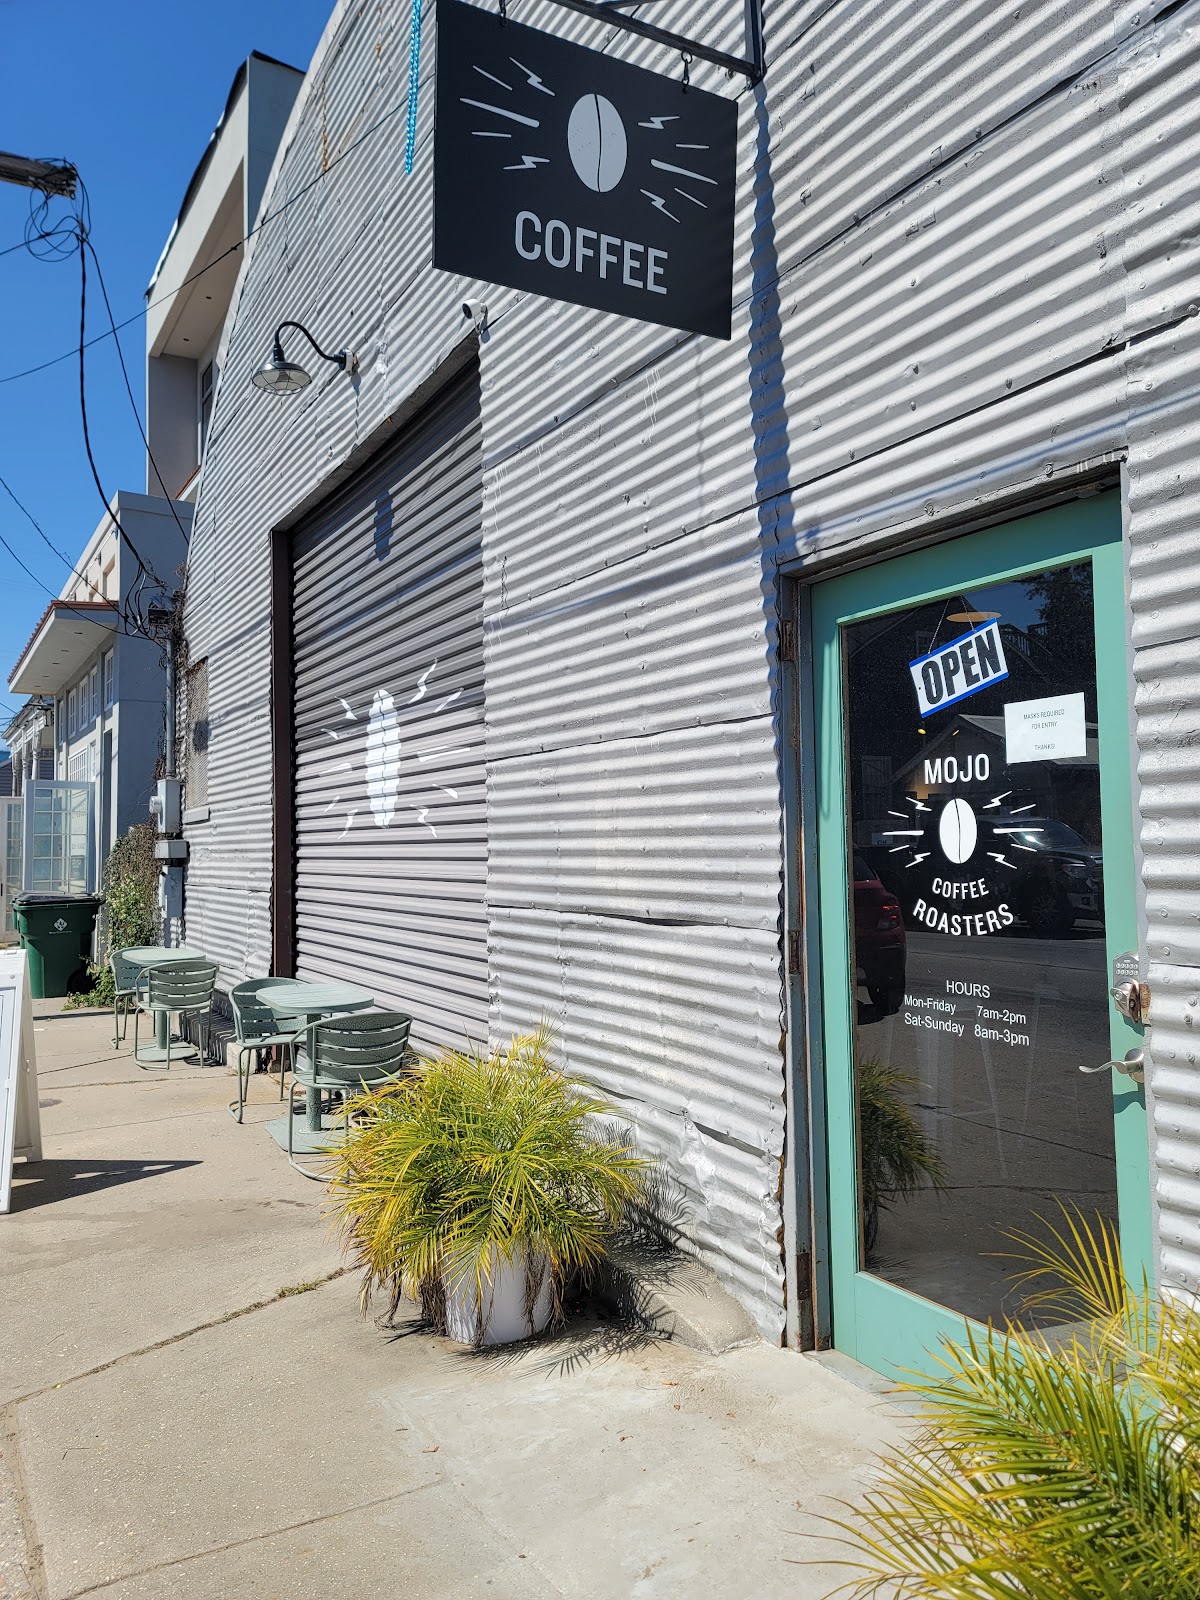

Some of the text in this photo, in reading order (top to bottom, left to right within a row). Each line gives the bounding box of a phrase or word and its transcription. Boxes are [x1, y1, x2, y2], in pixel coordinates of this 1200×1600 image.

[515, 211, 668, 295] COFFEE
[921, 627, 1002, 705] OPEN
[1023, 708, 1065, 720] MASKS REQUIRED
[1041, 721, 1058, 729] ENTRY
[1034, 743, 1056, 751] THANKS!
[924, 753, 990, 784] MOJO
[932, 877, 990, 900] COFFEE
[912, 898, 1014, 936] ROASTERS
[946, 980, 991, 999] HOURS
[904, 995, 1027, 1025] Mon-Friday 7am-2pm
[904, 1012, 1030, 1047] Sat-Sunday 8am-3pm
